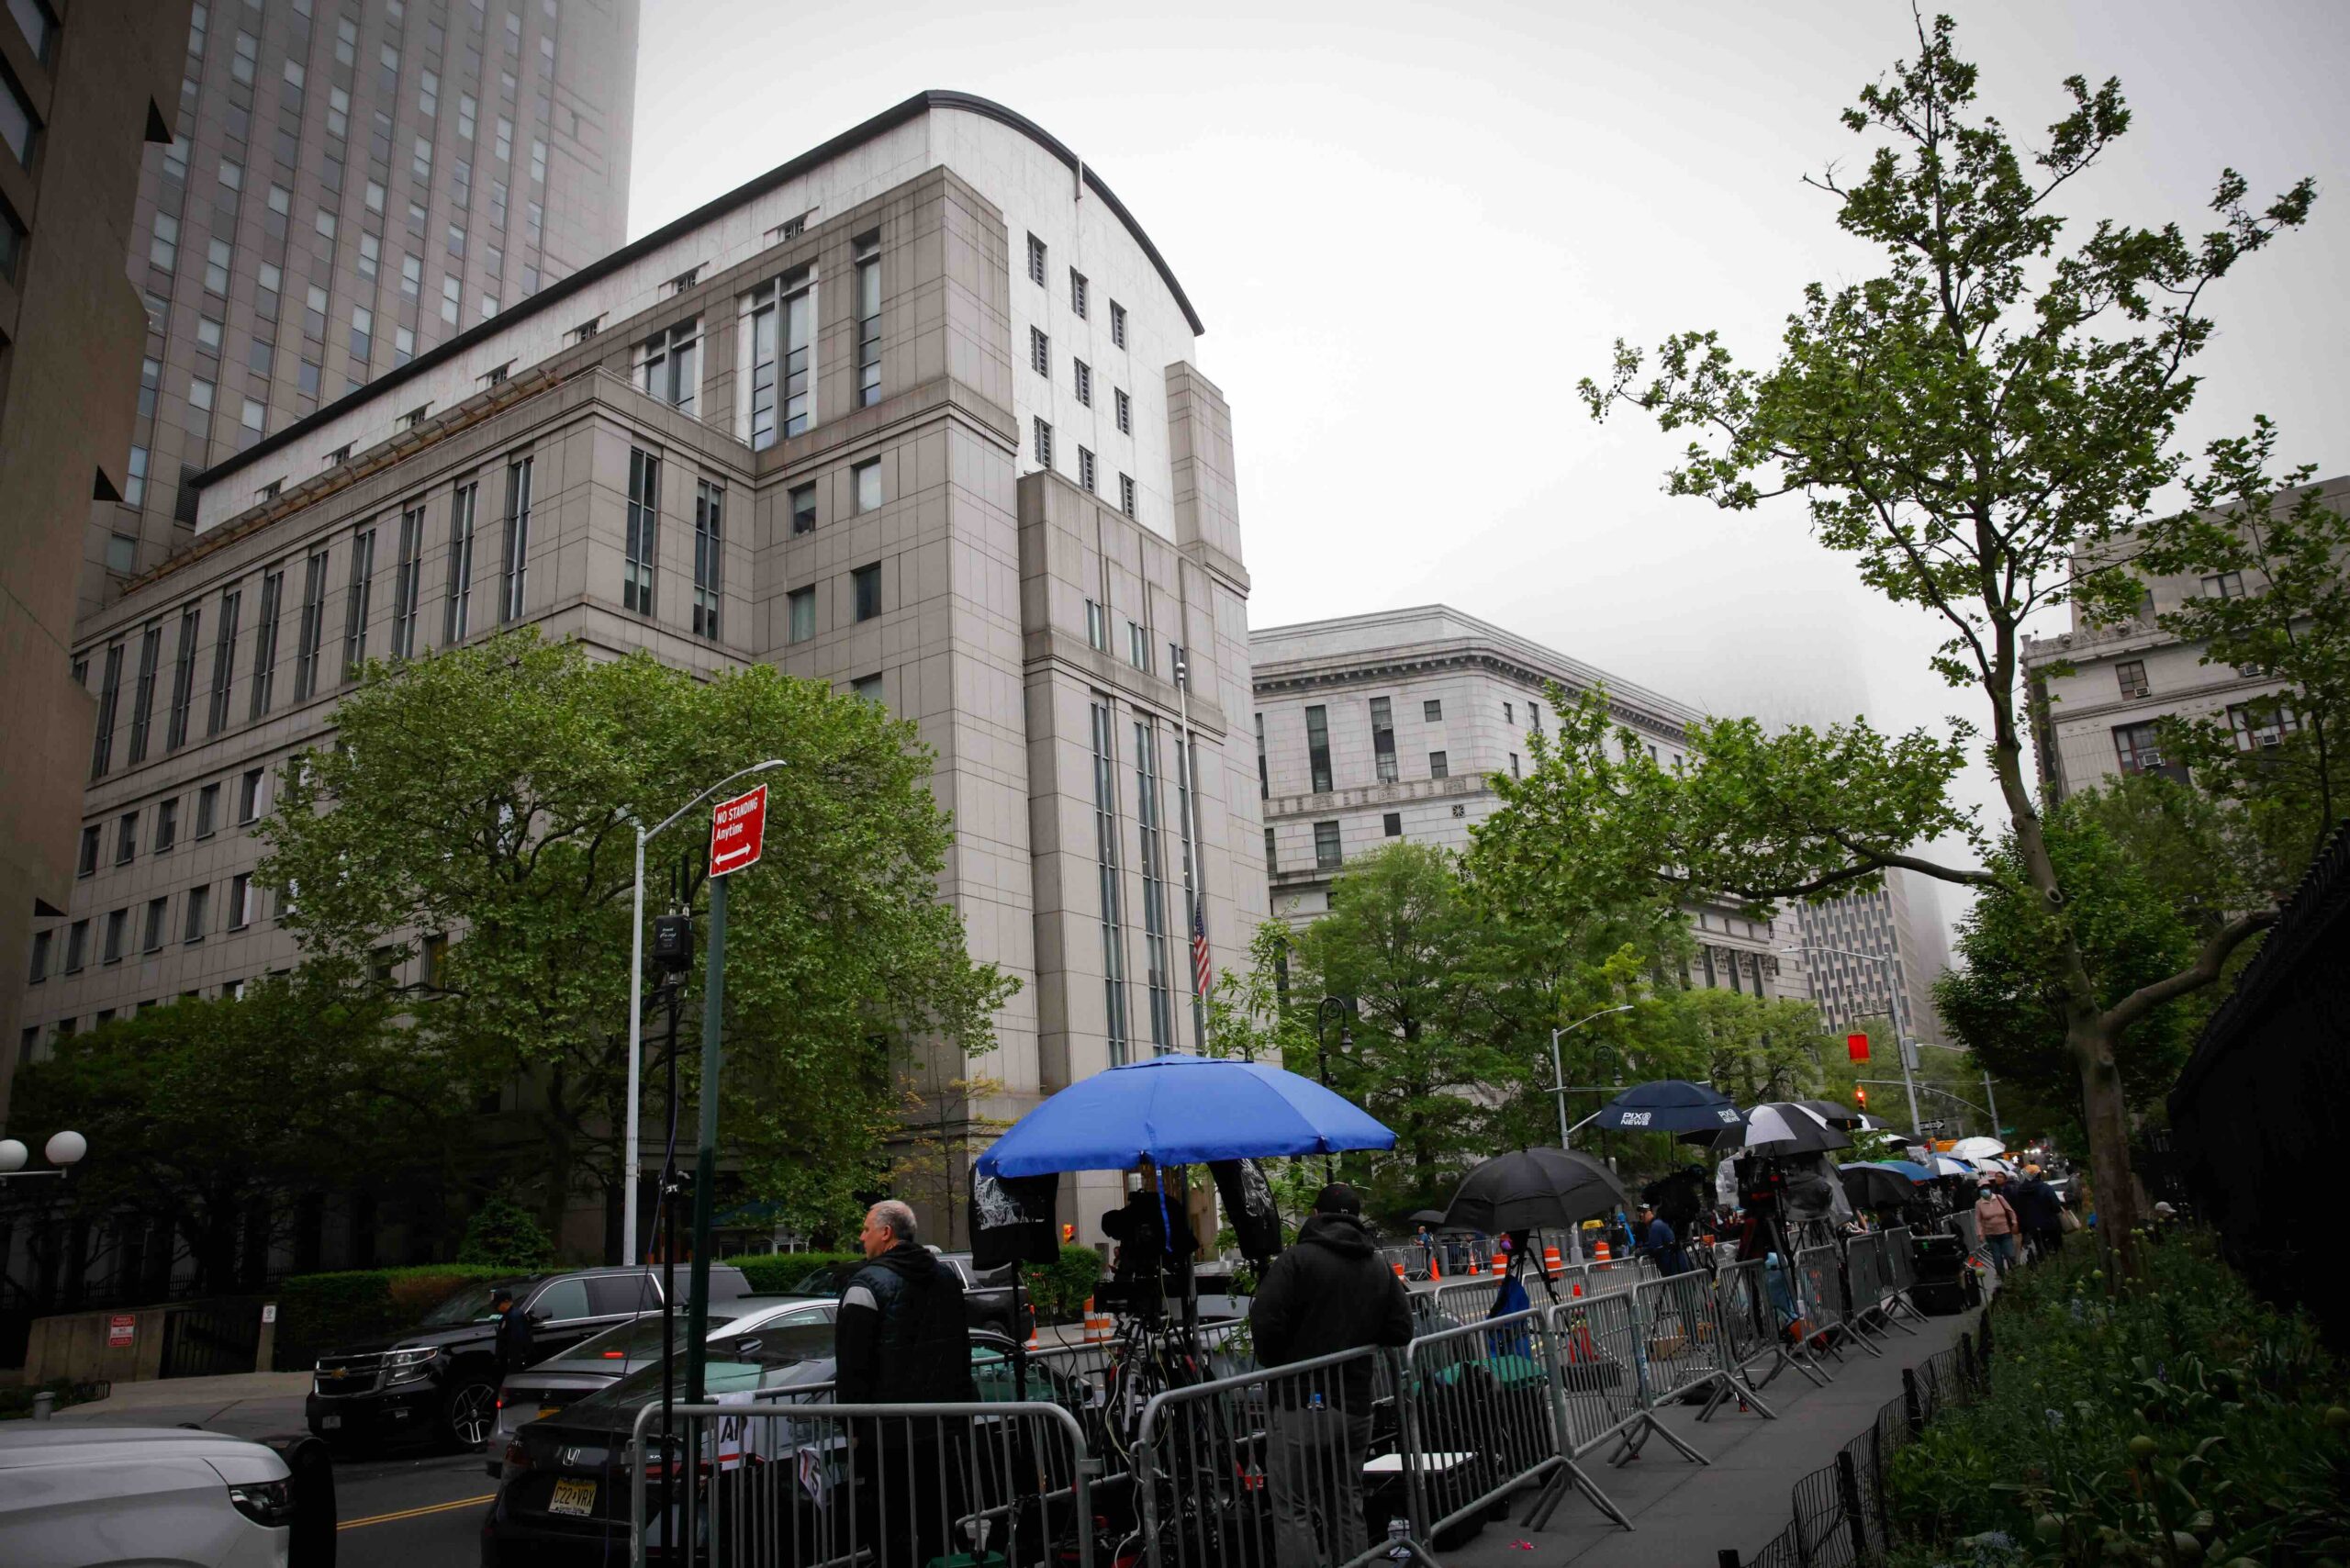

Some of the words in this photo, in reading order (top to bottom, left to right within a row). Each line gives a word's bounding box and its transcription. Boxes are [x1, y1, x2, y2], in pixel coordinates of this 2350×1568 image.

[717, 810, 728, 825] NO
[728, 796, 758, 822] STANDING
[716, 822, 744, 841] Anytime
[554, 1485, 573, 1505] C22
